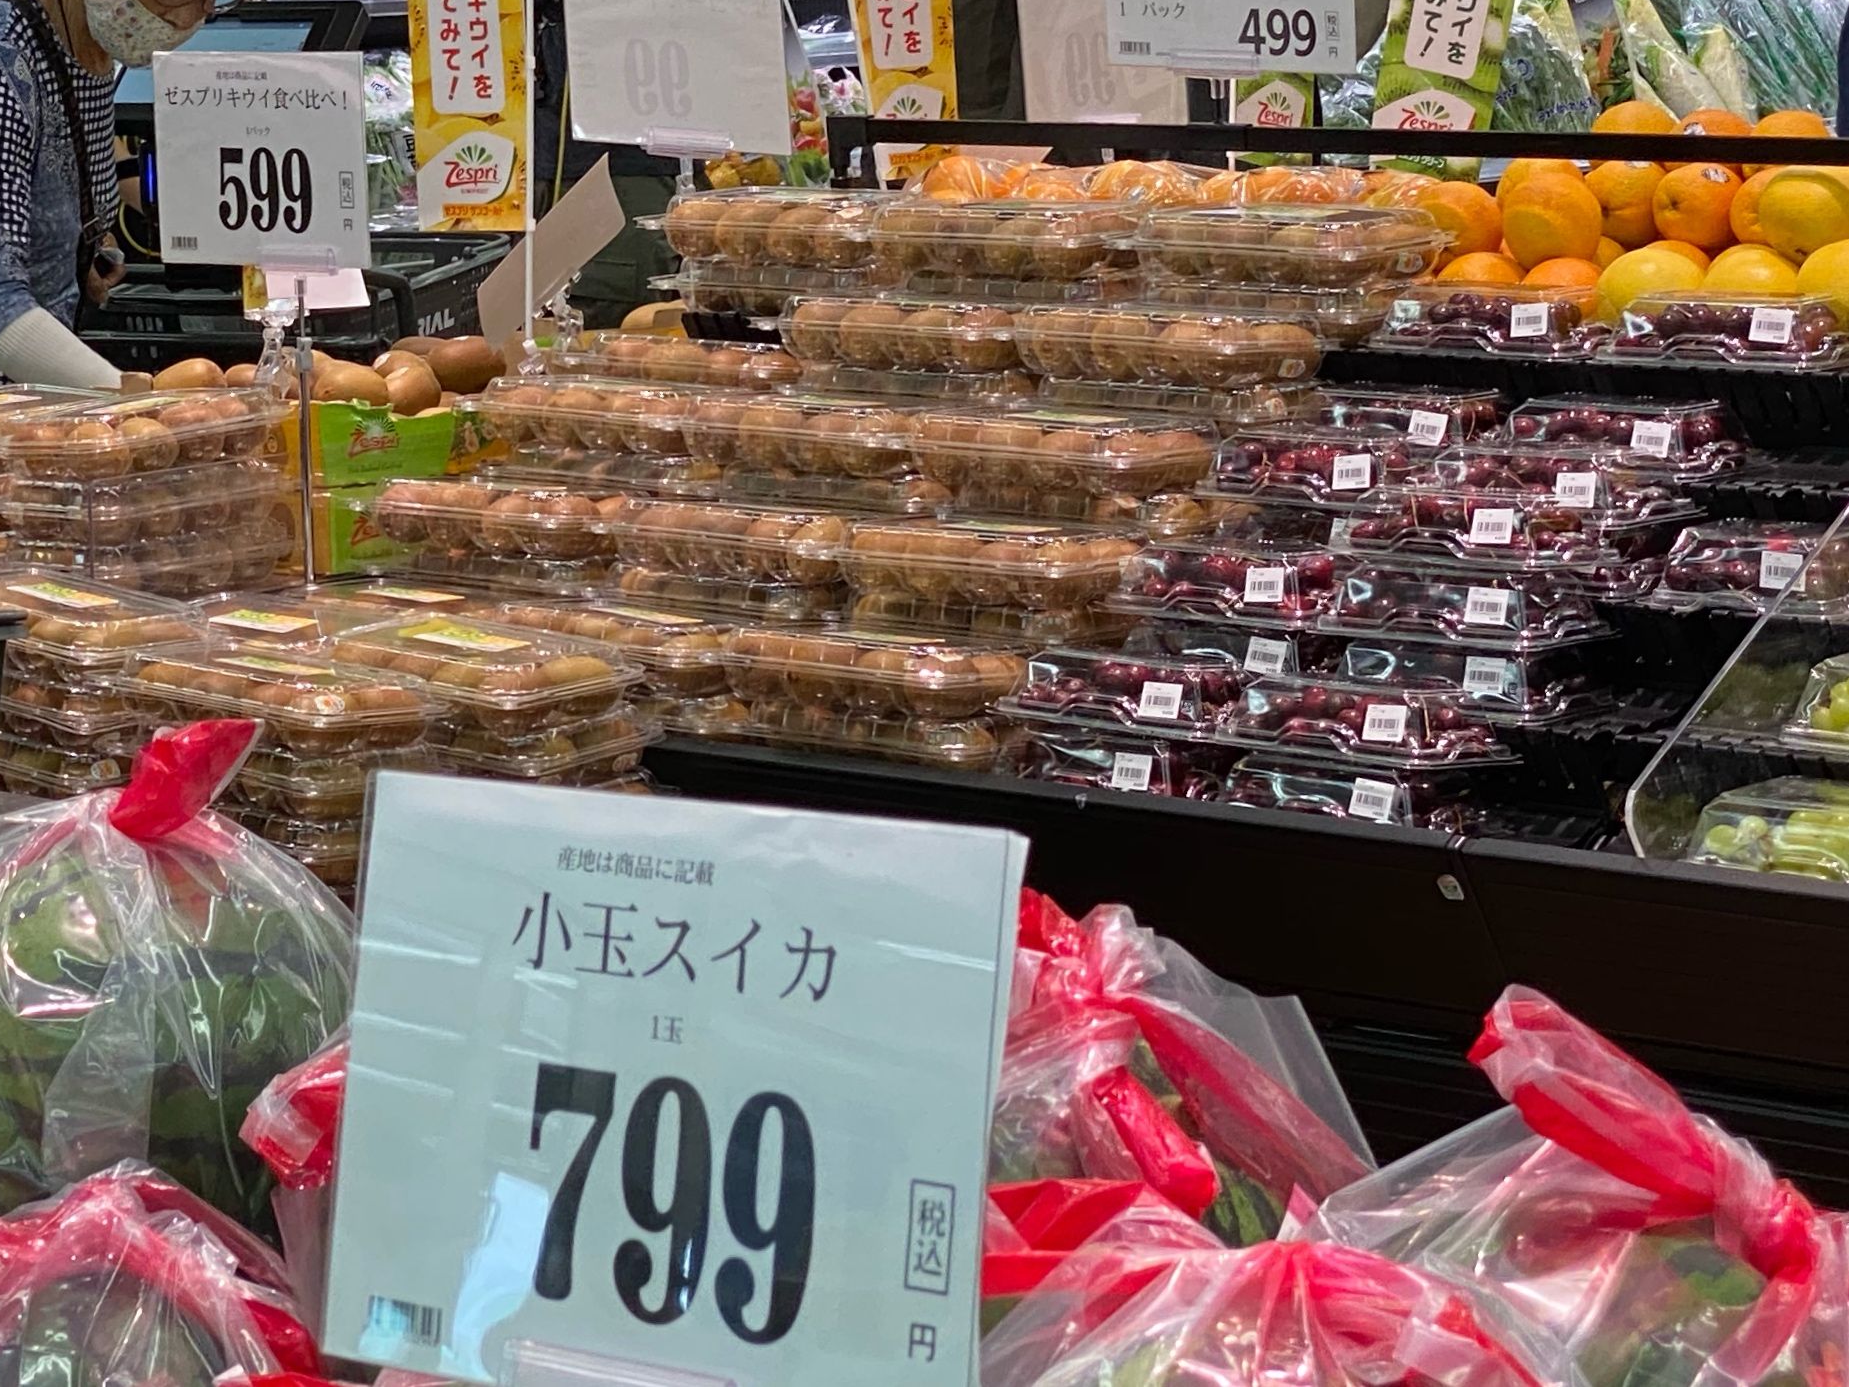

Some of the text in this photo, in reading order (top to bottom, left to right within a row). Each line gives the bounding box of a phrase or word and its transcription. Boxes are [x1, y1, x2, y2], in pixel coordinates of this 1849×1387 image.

[1141, 2, 1186, 20] パック
[1238, 7, 1317, 58] 499
[164, 86, 348, 111] ゼスプリキウイ食べ比べ！
[219, 146, 313, 235] 599
[444, 160, 500, 188] Zespri
[557, 845, 714, 888] 産地は商品に記載
[512, 891, 838, 1003] 小玉スイカ
[650, 1016, 684, 1045] 1玉
[529, 1063, 816, 1346] 799
[908, 1198, 946, 1361] 税込 円
